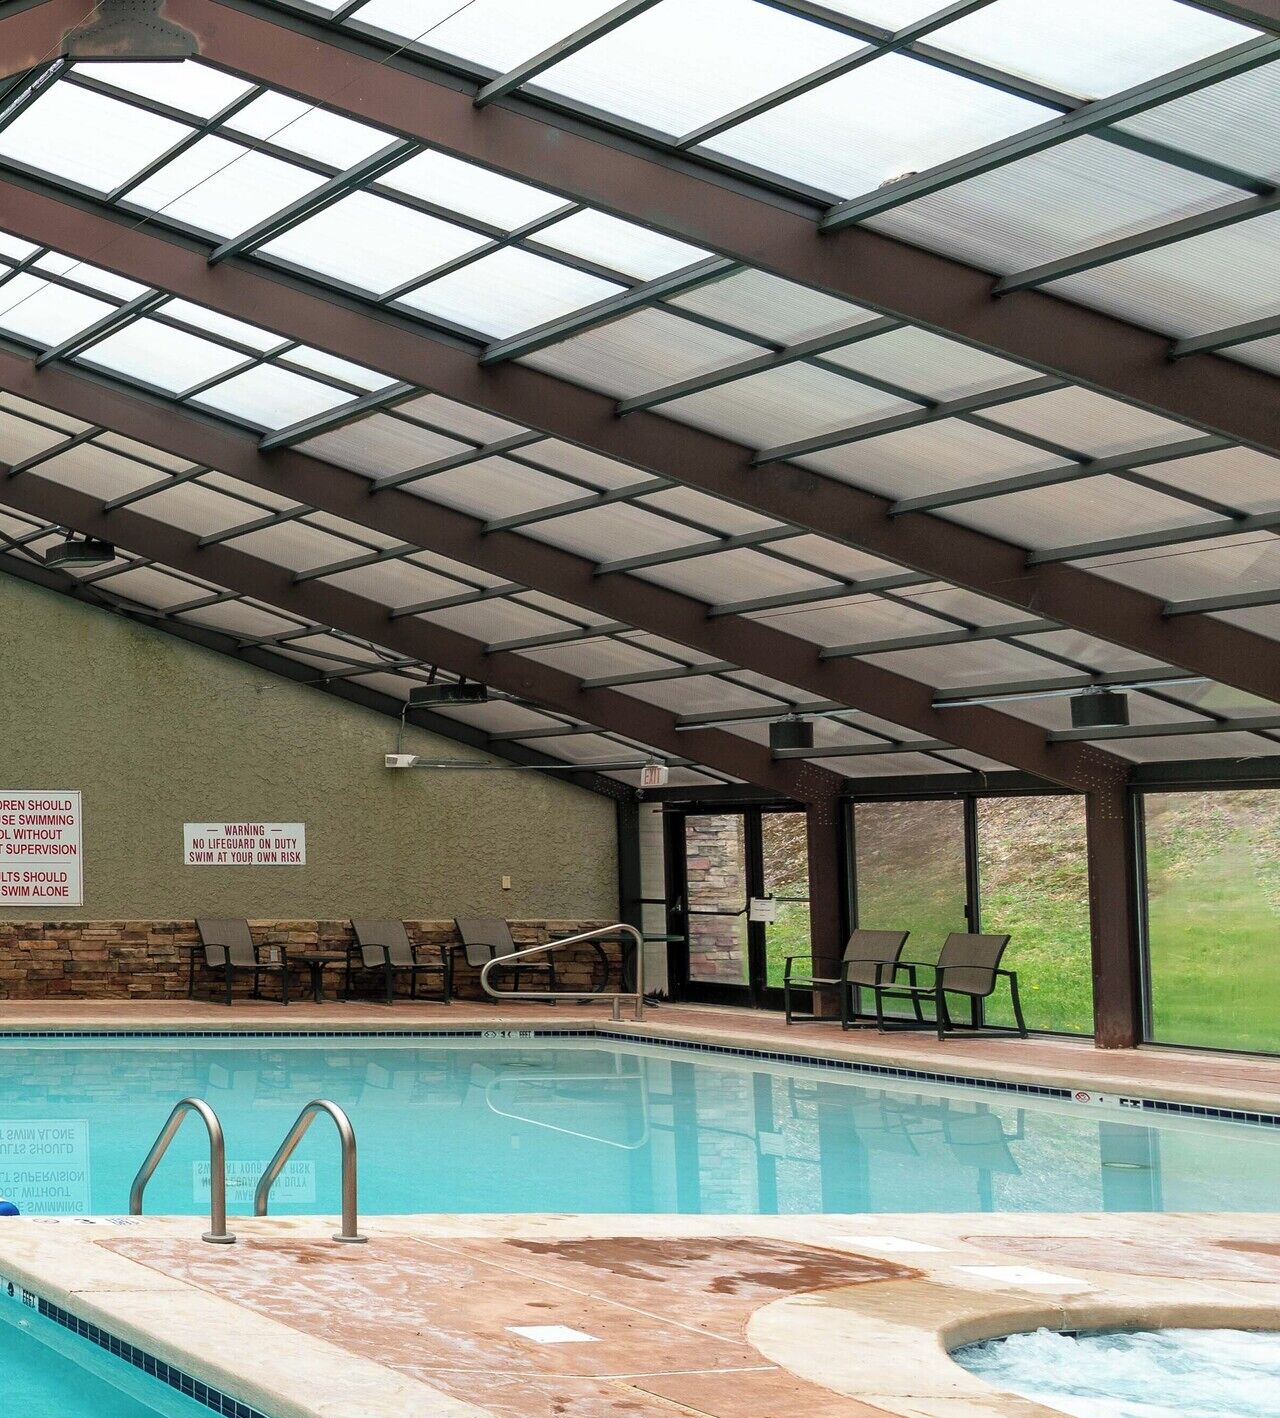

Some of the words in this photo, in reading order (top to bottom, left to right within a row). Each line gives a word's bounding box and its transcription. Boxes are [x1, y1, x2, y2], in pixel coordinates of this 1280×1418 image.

[645, 768, 661, 784] EXIT
[28, 800, 72, 811] SHOULD
[18, 815, 74, 826] SWIMMING
[13, 829, 63, 840] WITHOUT
[224, 825, 265, 836] WARNING
[192, 838, 205, 849] NO
[208, 838, 255, 849] LIFEGUARD
[259, 838, 271, 849] ON
[274, 838, 297, 849] DUTY
[6, 844, 77, 855] SUPERVISION
[189, 852, 214, 863] SWIM
[217, 852, 228, 862] AT
[231, 852, 253, 862] YOUR
[257, 852, 277, 862] OWN
[281, 851, 301, 863] RISK
[23, 872, 67, 882] SHOULD
[1, 886, 30, 896] SWIM
[32, 885, 69, 896] ALONE
